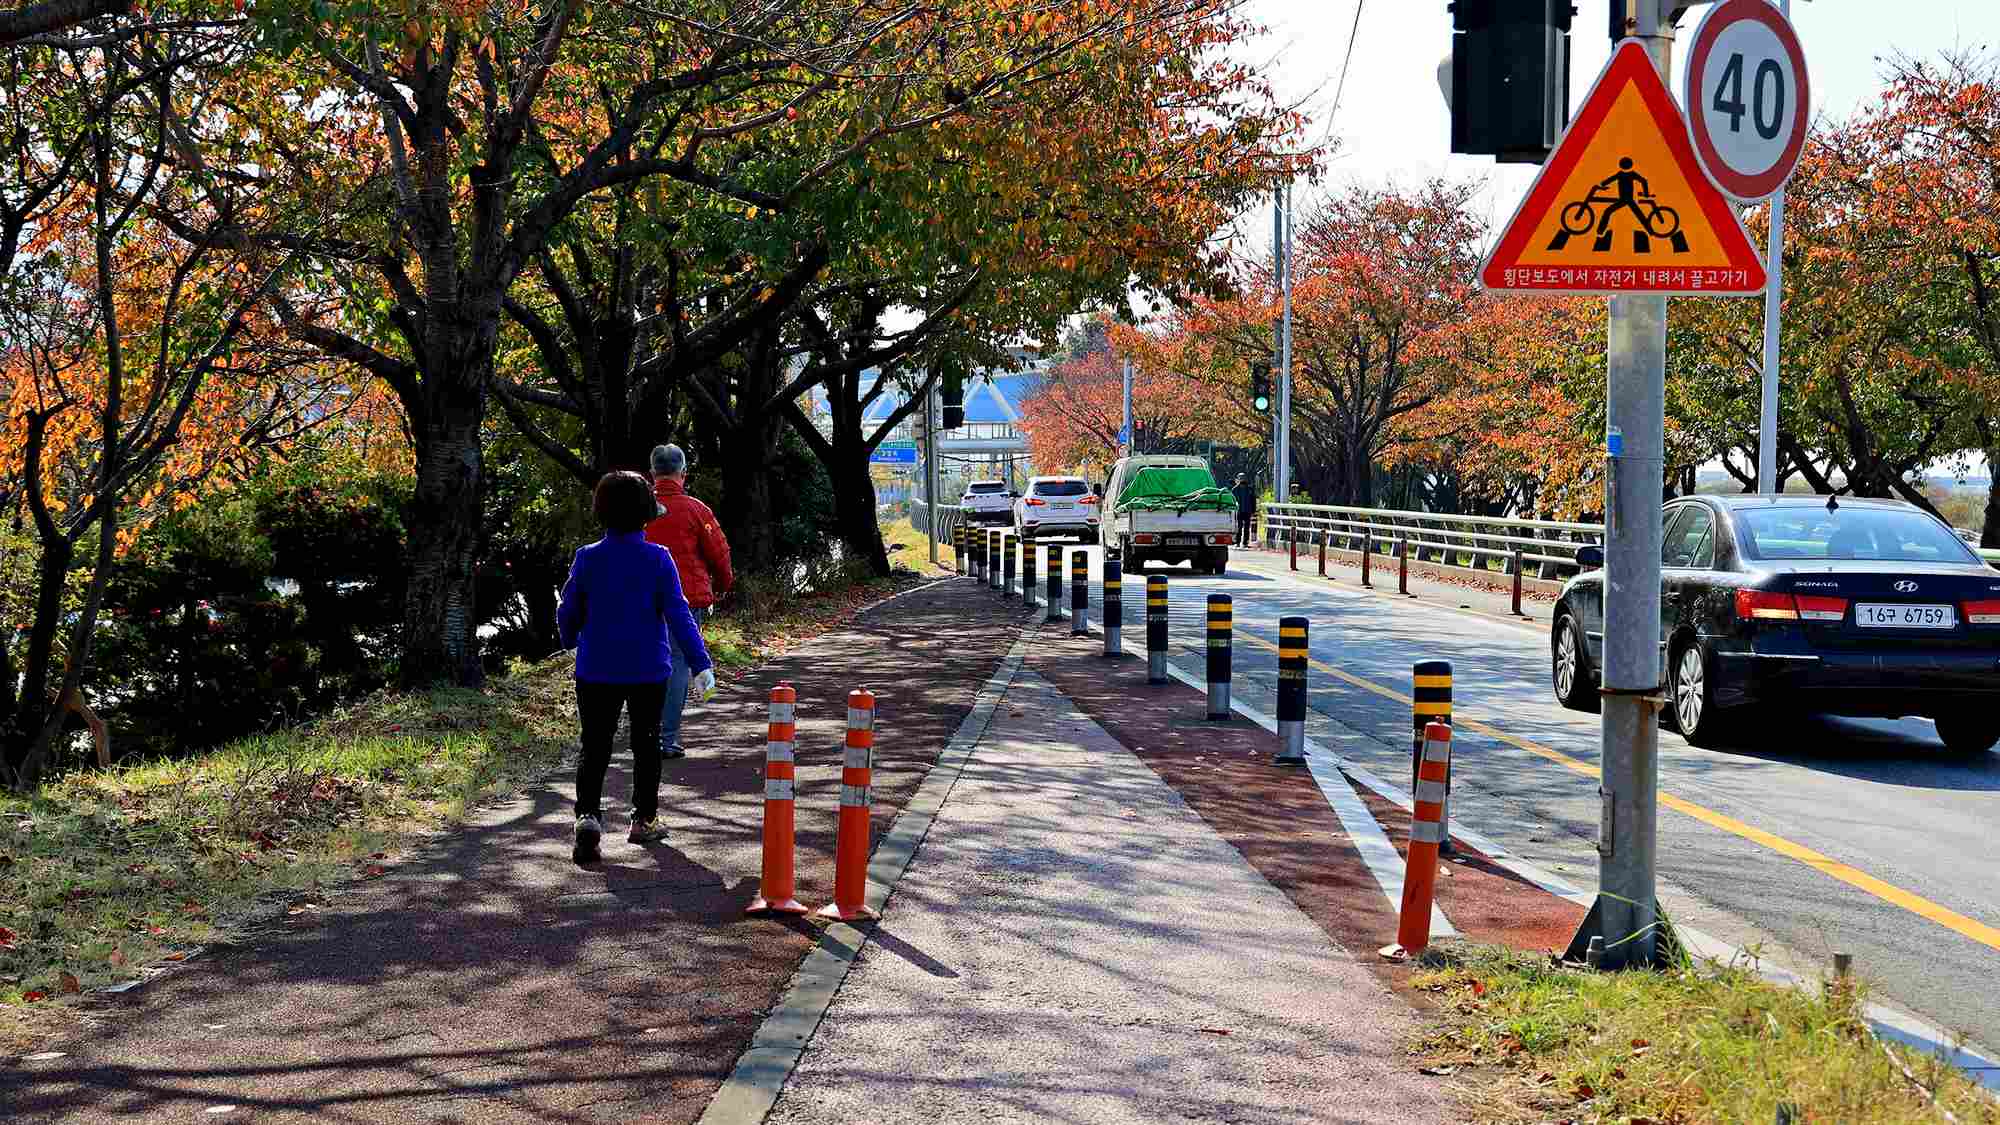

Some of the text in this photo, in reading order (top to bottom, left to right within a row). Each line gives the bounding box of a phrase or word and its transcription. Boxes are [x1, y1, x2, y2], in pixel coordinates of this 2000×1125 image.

[1712, 52, 1785, 140] 40
[1503, 268, 1747, 288] 횡단보도에서 자전거 내려서 끌고가기
[1867, 607, 1944, 624] 16구 6759
